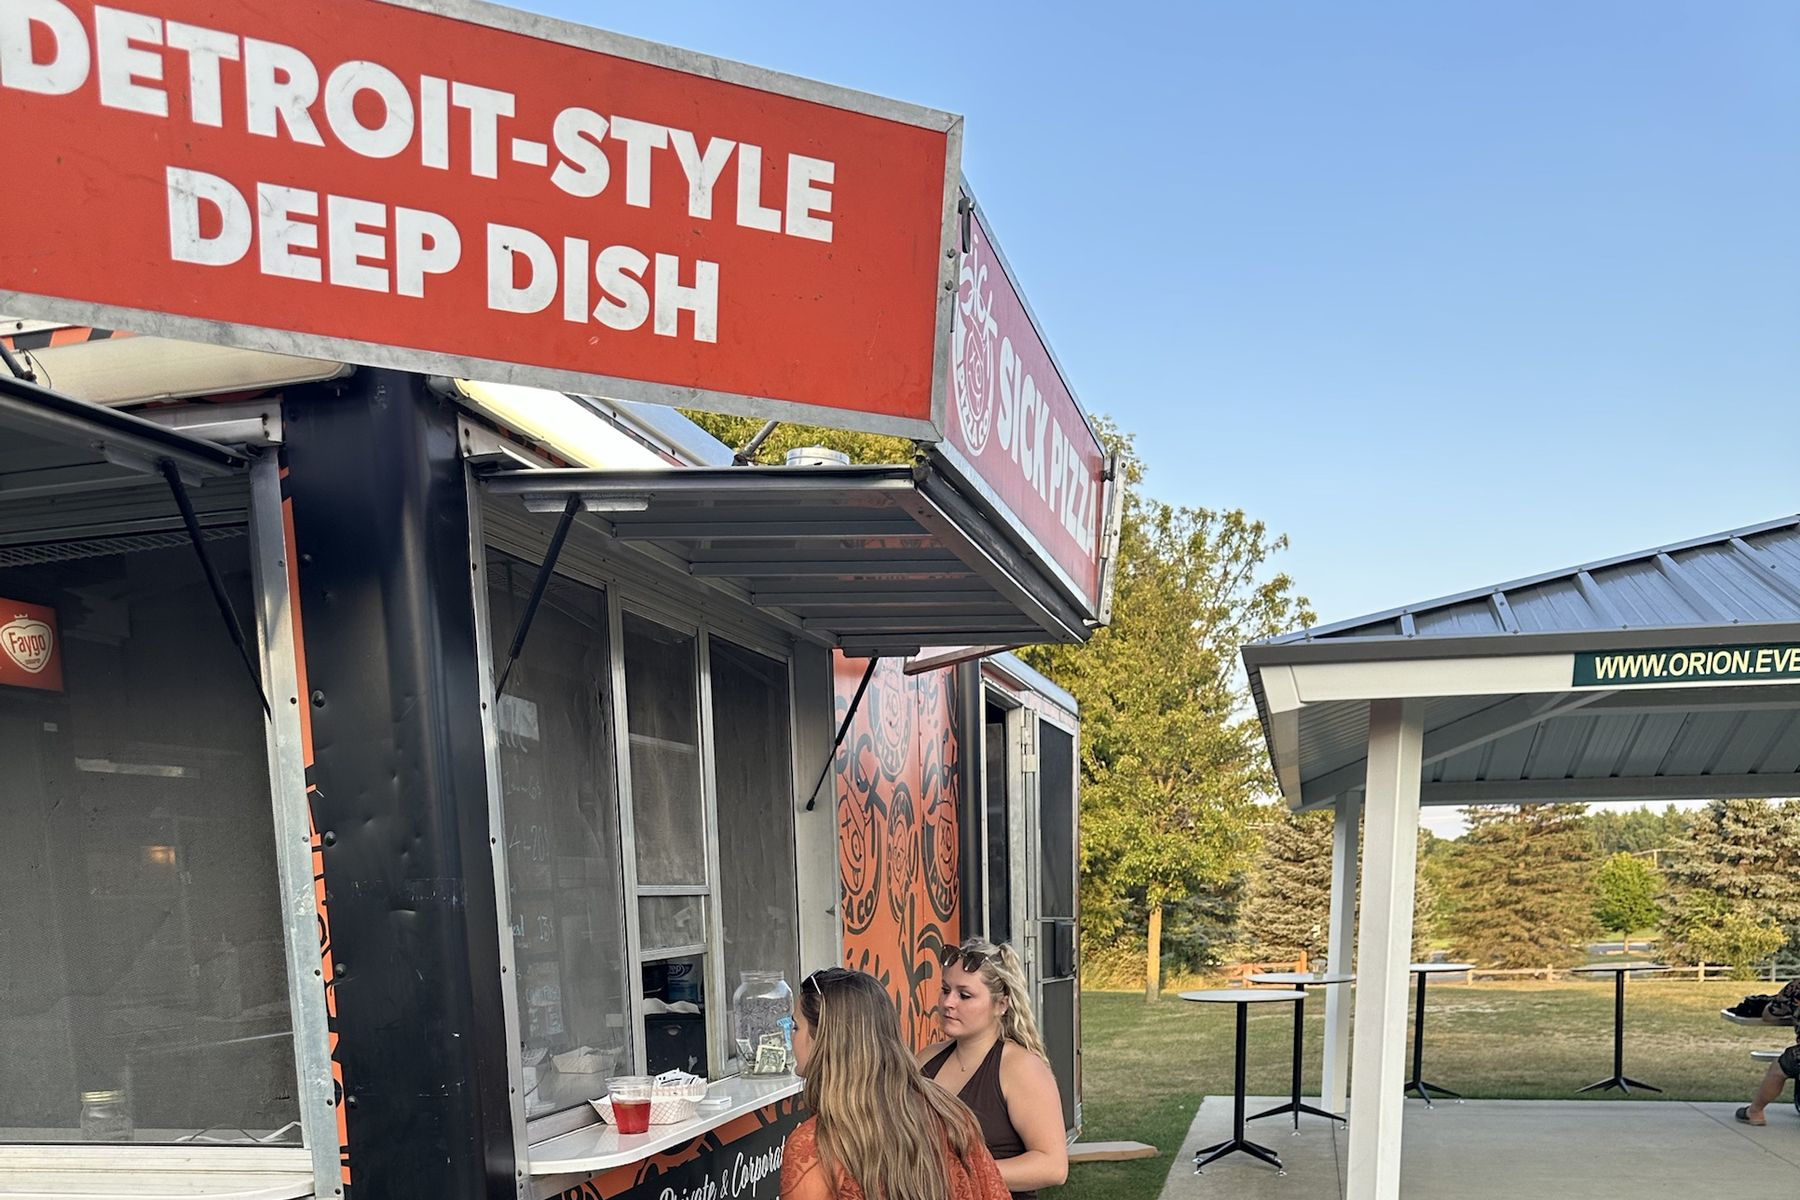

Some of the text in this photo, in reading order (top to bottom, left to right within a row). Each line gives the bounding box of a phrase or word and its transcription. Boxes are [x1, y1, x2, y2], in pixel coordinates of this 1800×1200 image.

[1, 0, 835, 243] DETROIT-STYLE
[166, 166, 720, 344] DEEP DISH
[997, 337, 1097, 566] SICK PIZZA
[8, 632, 46, 657] Faygo
[1595, 648, 1800, 680] WWW.ORION.EVE
[720, 1169, 729, 1198] &
